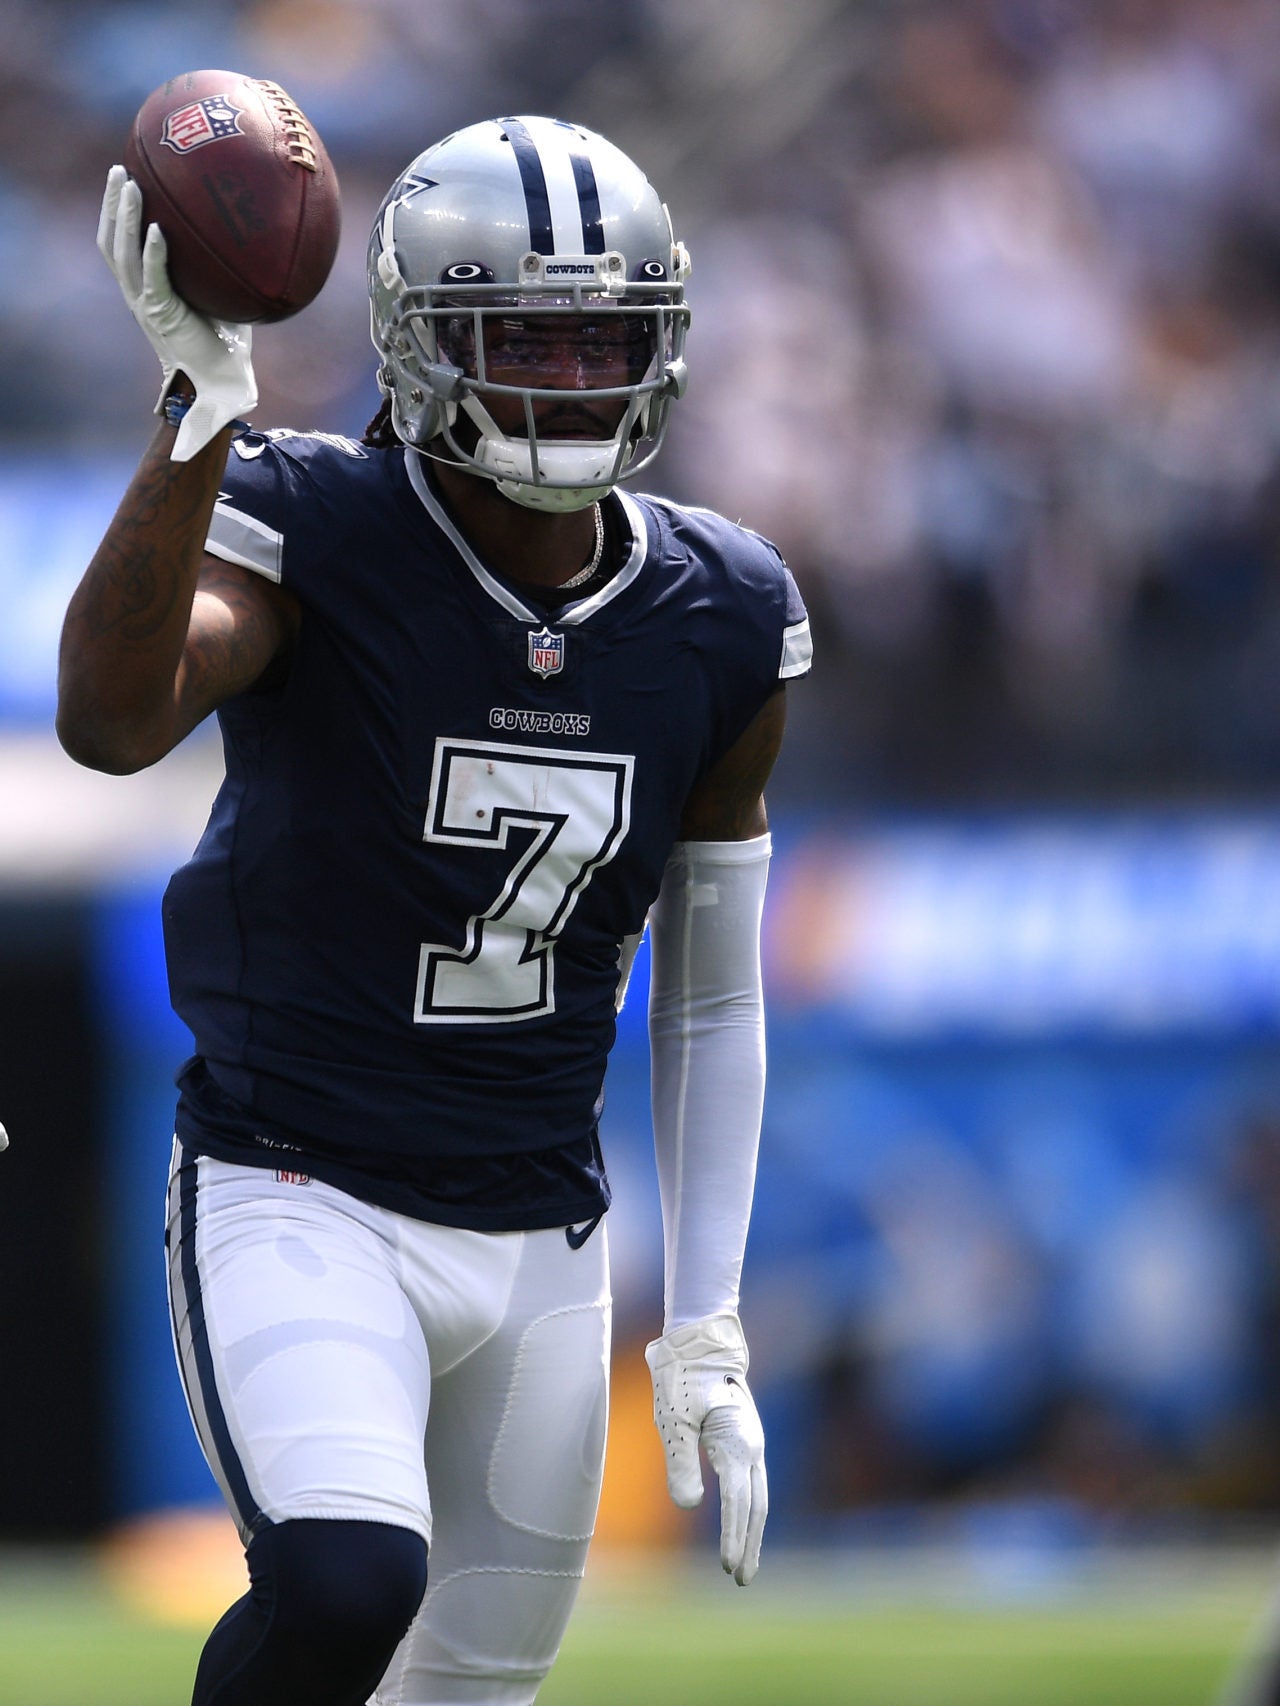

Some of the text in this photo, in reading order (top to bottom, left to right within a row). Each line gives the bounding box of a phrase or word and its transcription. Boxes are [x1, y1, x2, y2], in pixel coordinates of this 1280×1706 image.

[171, 105, 216, 147] NFL
[546, 264, 595, 274] COWBOYS
[534, 650, 558, 669] NFL
[489, 708, 590, 735] COWBOYS
[414, 737, 636, 1024] 7
